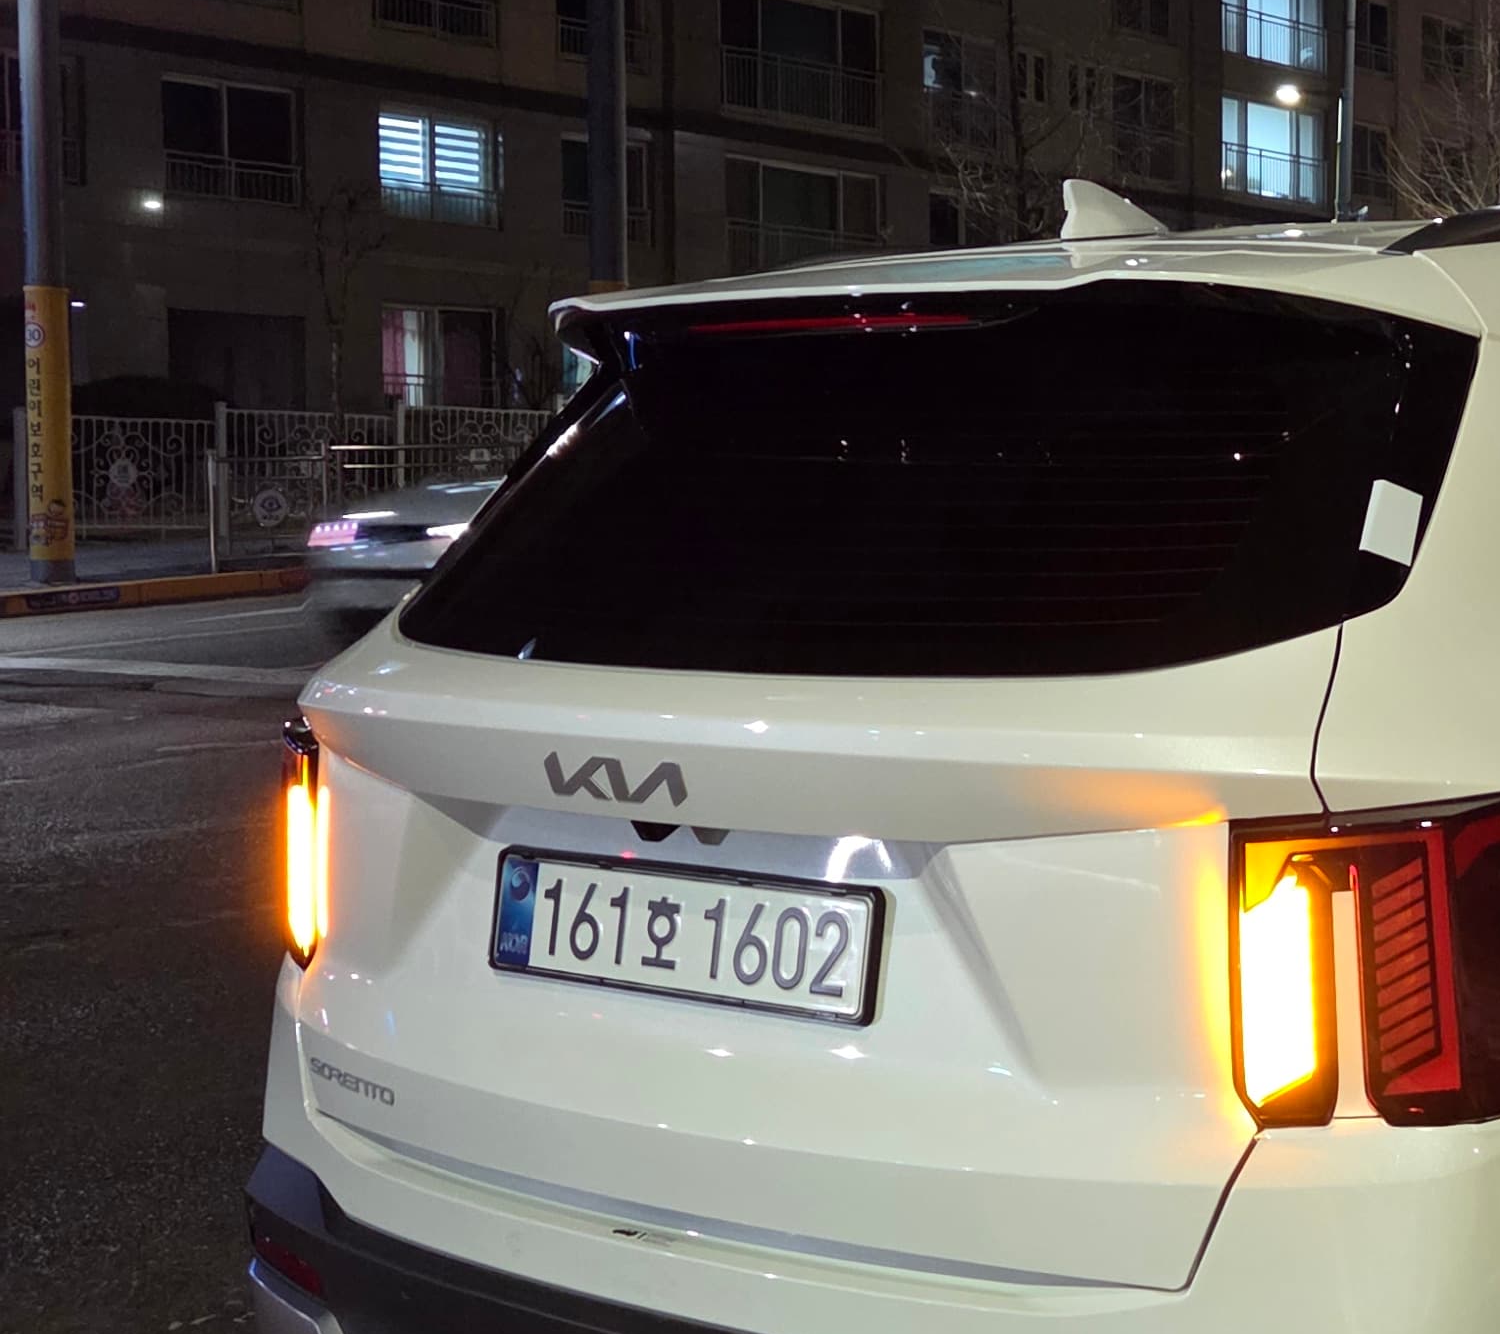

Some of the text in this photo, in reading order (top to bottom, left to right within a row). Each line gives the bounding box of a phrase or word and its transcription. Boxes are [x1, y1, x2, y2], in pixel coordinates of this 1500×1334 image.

[543, 750, 689, 807] KIA
[541, 876, 850, 999] 161호 1602
[309, 1056, 396, 1107] SORENTO
